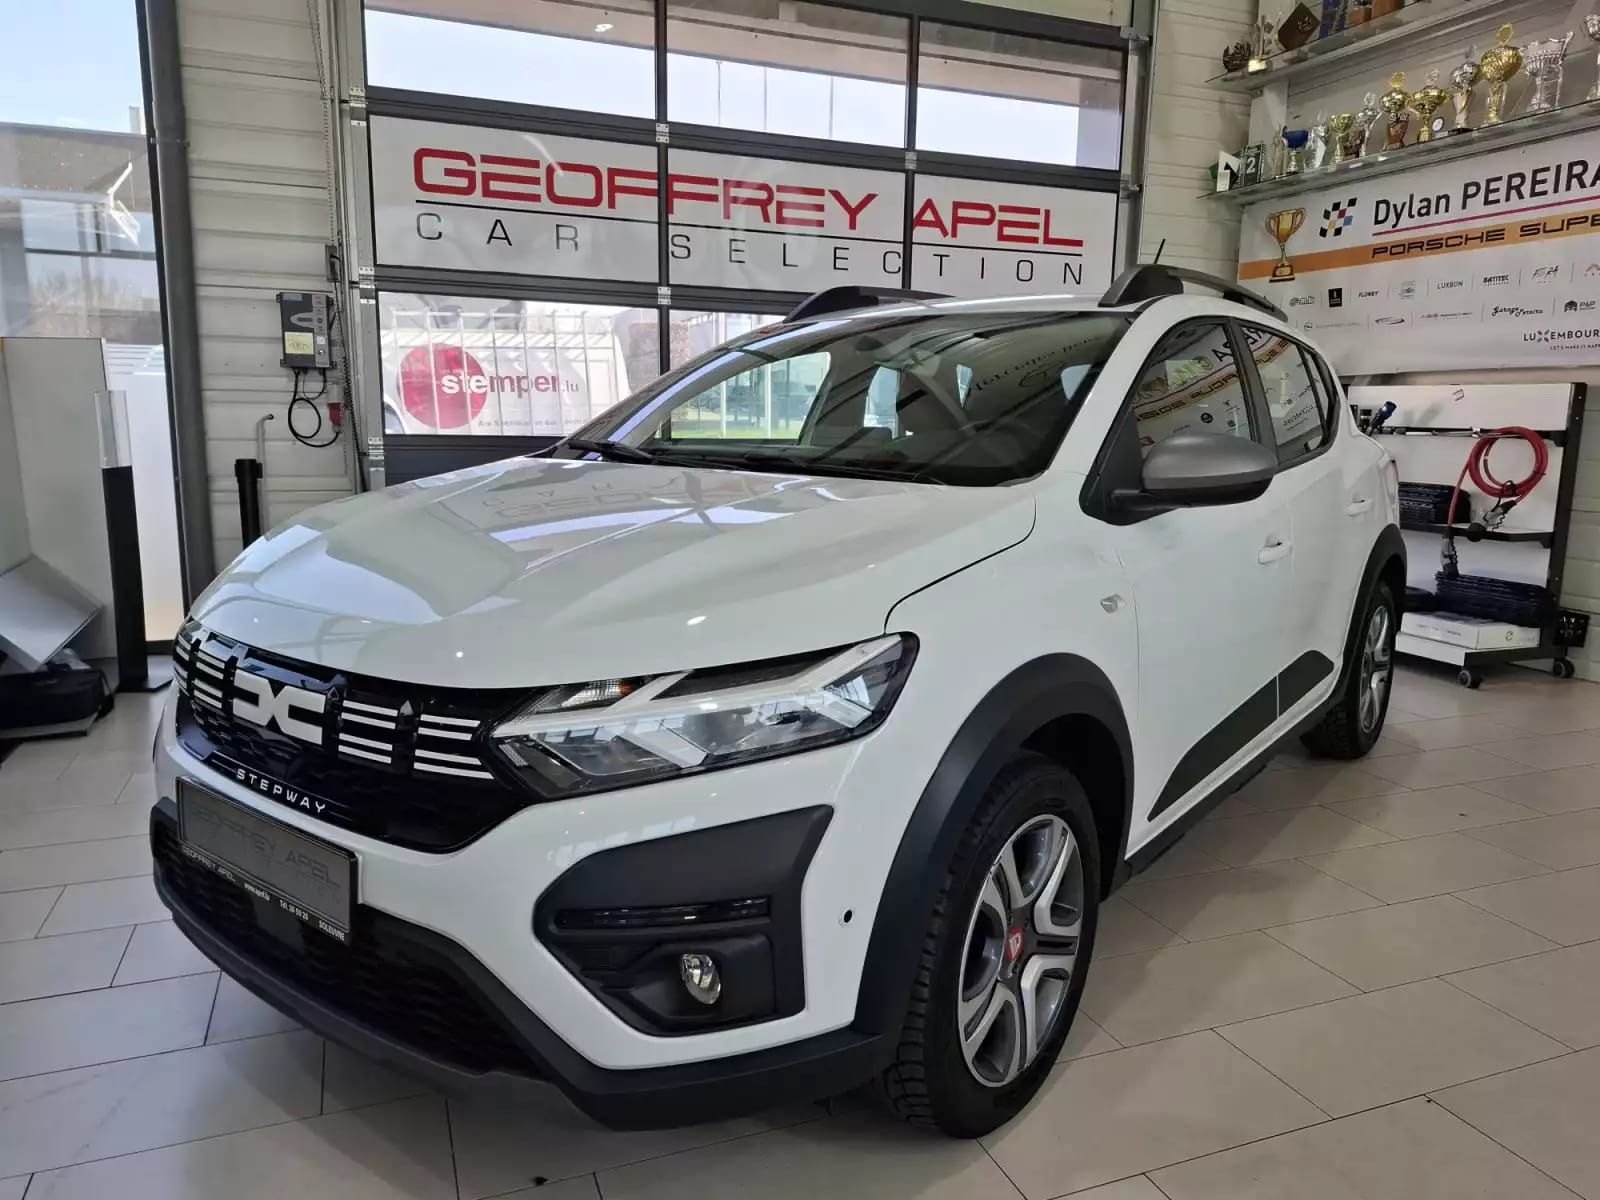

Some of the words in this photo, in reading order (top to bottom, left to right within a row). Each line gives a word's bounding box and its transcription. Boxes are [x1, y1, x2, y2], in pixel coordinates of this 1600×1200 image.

[414, 147, 878, 231] GEOFFREY
[912, 198, 1084, 247] APEL
[1373, 192, 1451, 228] Dylan
[415, 212, 579, 252] CAR
[671, 234, 1083, 285] SELECTION
[1371, 228, 1506, 259] PORSCHE
[1491, 305, 1519, 317] Garage
[1515, 307, 1544, 318] Pereira
[441, 371, 579, 399] stemper.lu
[236, 768, 326, 813] STEPWAY
[318, 919, 345, 942] SOLEUVRE
